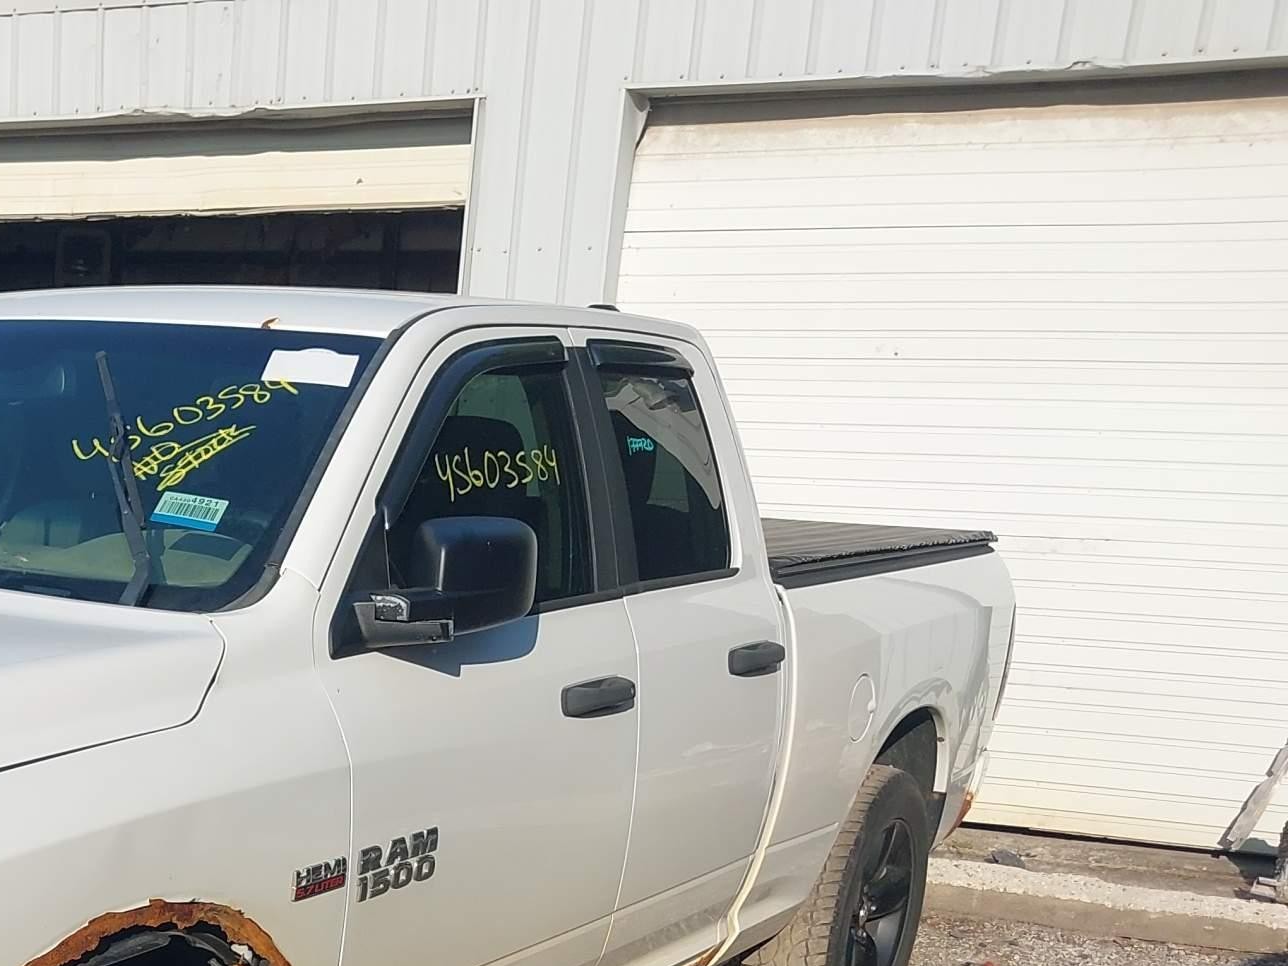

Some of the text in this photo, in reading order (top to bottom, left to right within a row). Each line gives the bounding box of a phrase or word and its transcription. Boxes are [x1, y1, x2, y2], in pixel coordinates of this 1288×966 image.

[434, 444, 561, 502] 45603584
[295, 856, 347, 888] HEMI
[357, 826, 439, 876] RAM
[356, 854, 436, 902] 1500
